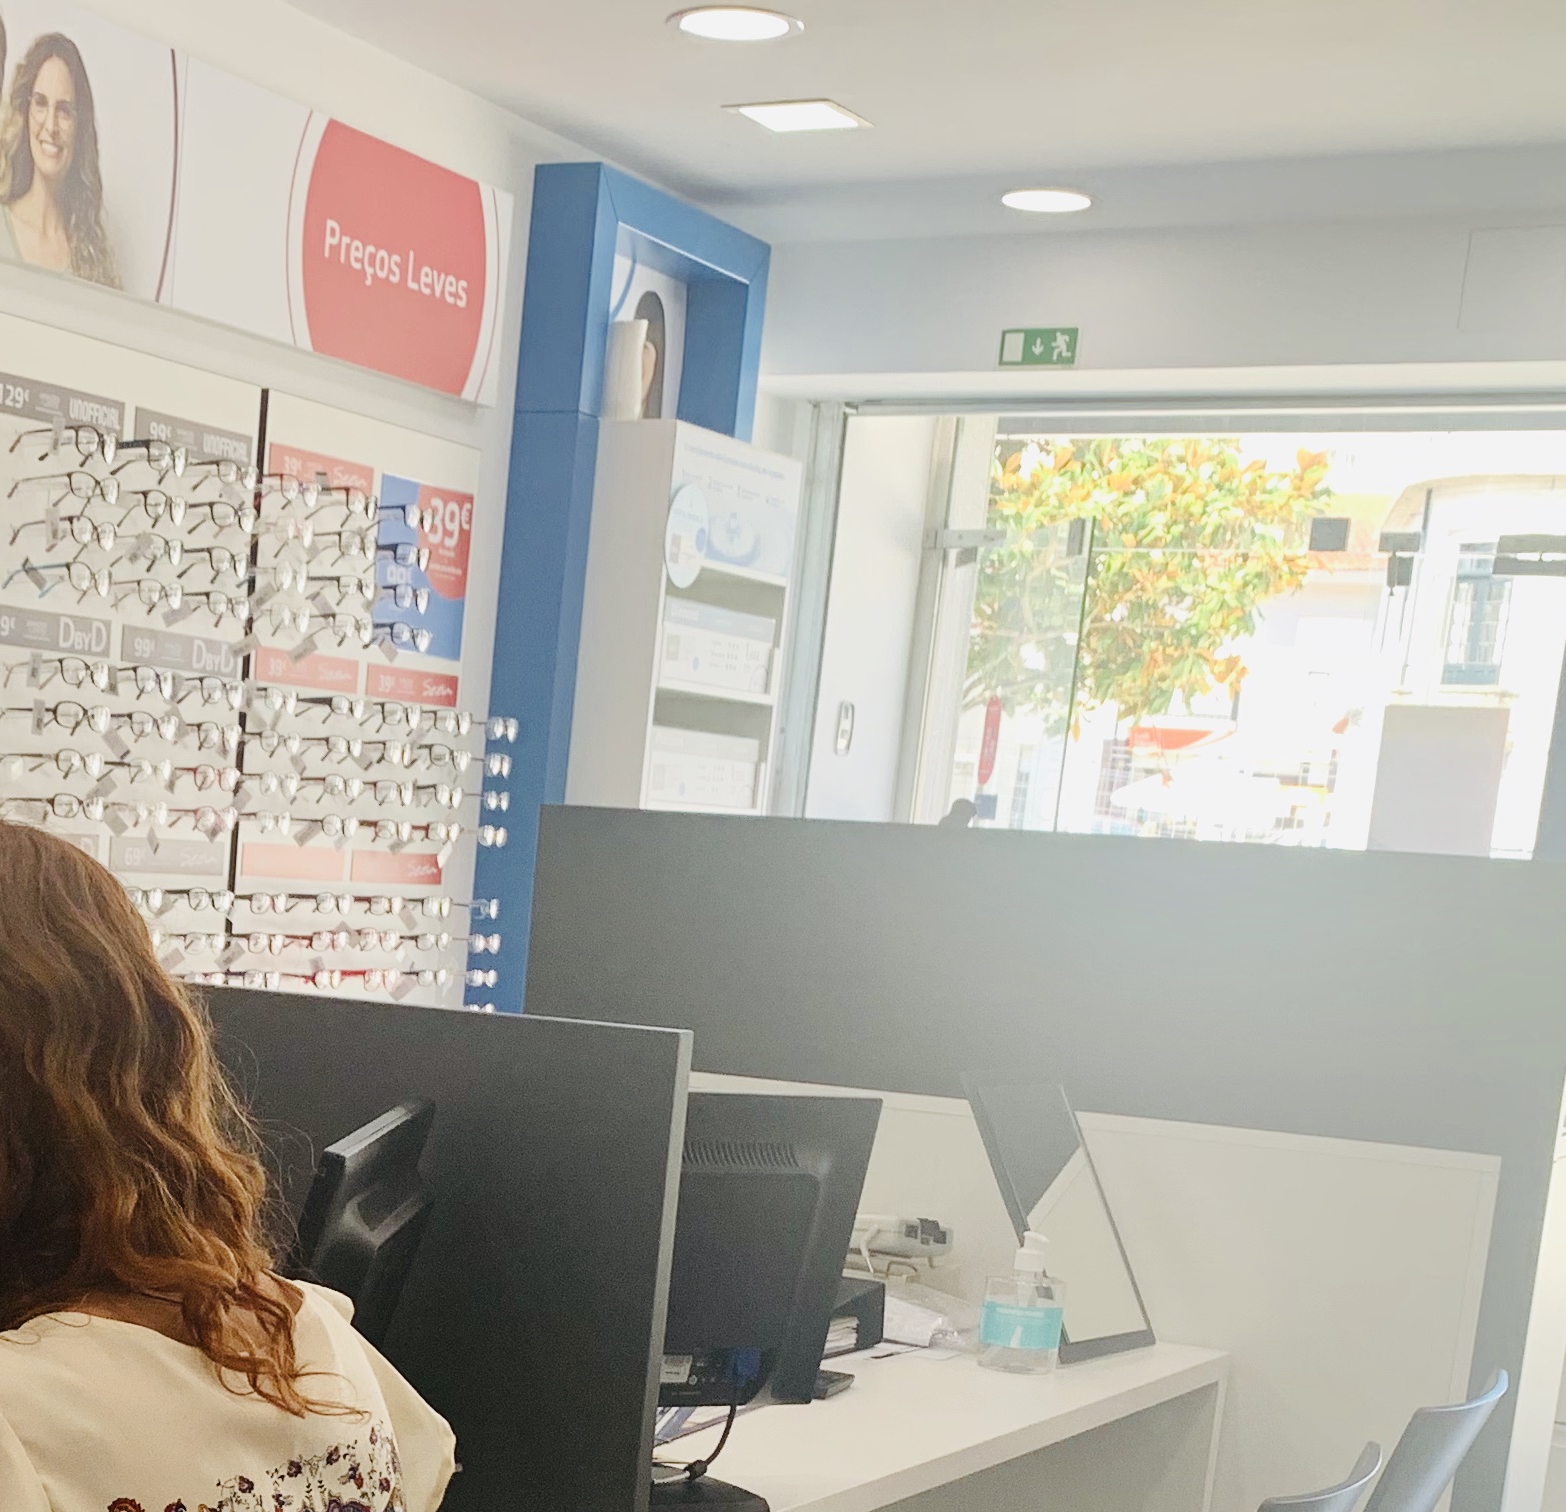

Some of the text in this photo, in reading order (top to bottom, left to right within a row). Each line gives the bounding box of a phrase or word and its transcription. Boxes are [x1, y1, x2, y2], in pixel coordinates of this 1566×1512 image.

[324, 219, 468, 308] Preços Leves
[69, 399, 121, 431] UNOFFICIAL
[427, 497, 472, 548] 39€
